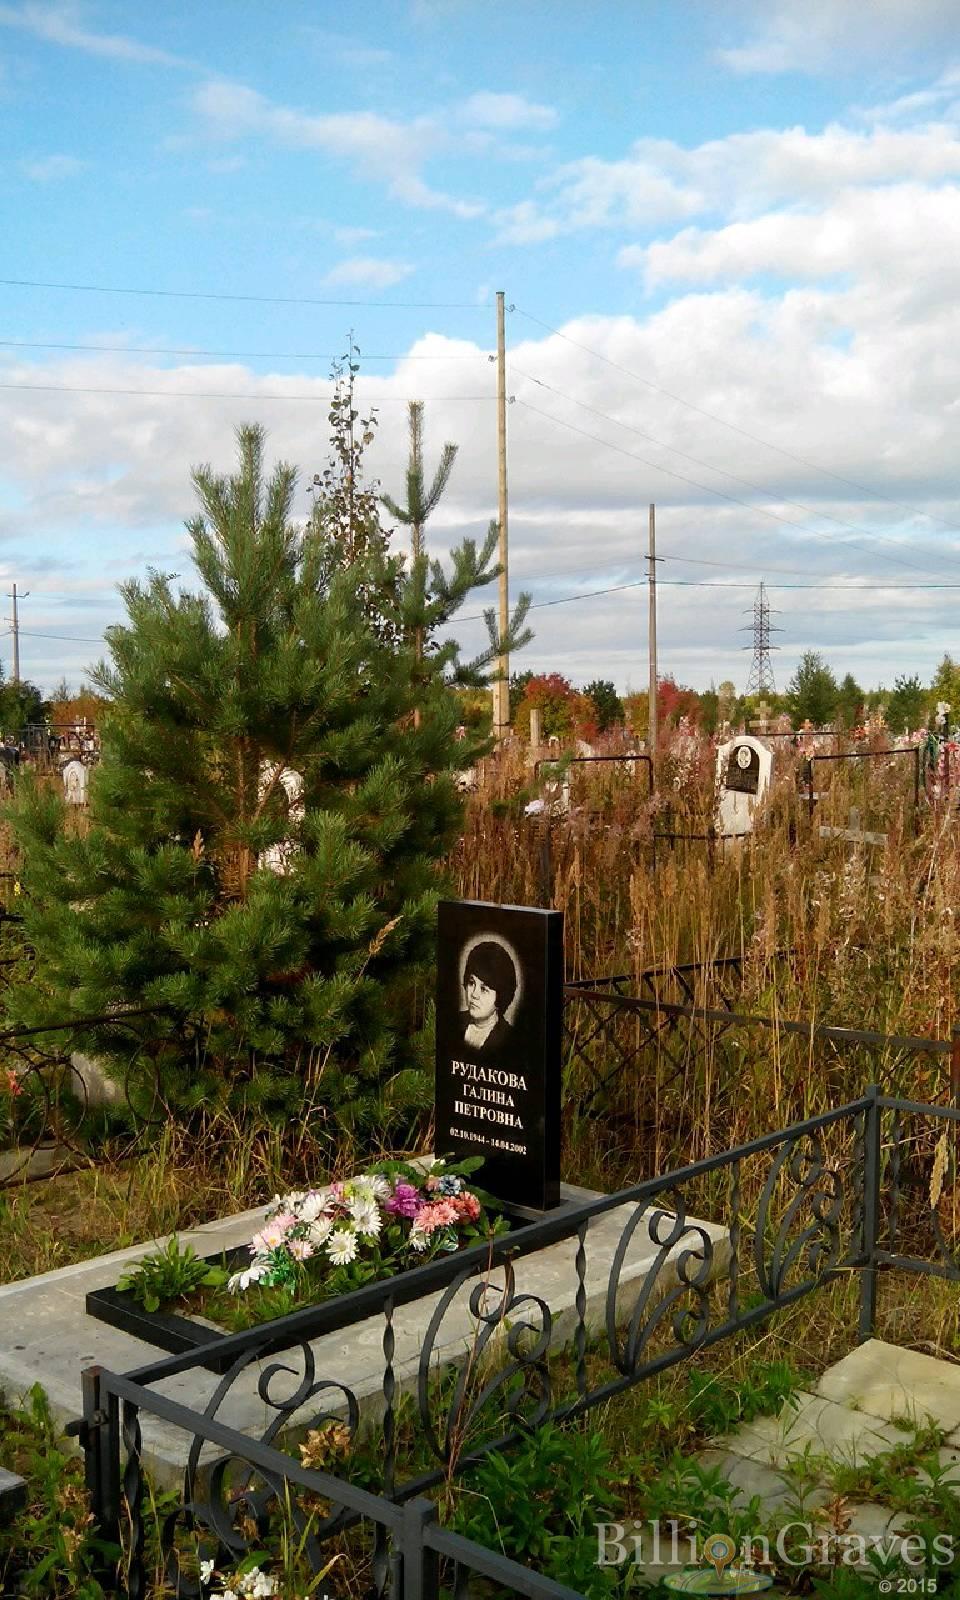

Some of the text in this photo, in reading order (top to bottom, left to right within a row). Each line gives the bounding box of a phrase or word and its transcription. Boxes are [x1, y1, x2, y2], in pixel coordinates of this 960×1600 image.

[451, 1060, 528, 1091] РУДАКОВА
[463, 1084, 515, 1107] ГАЛИНА
[454, 1100, 524, 1129] ПЕТРОВНА
